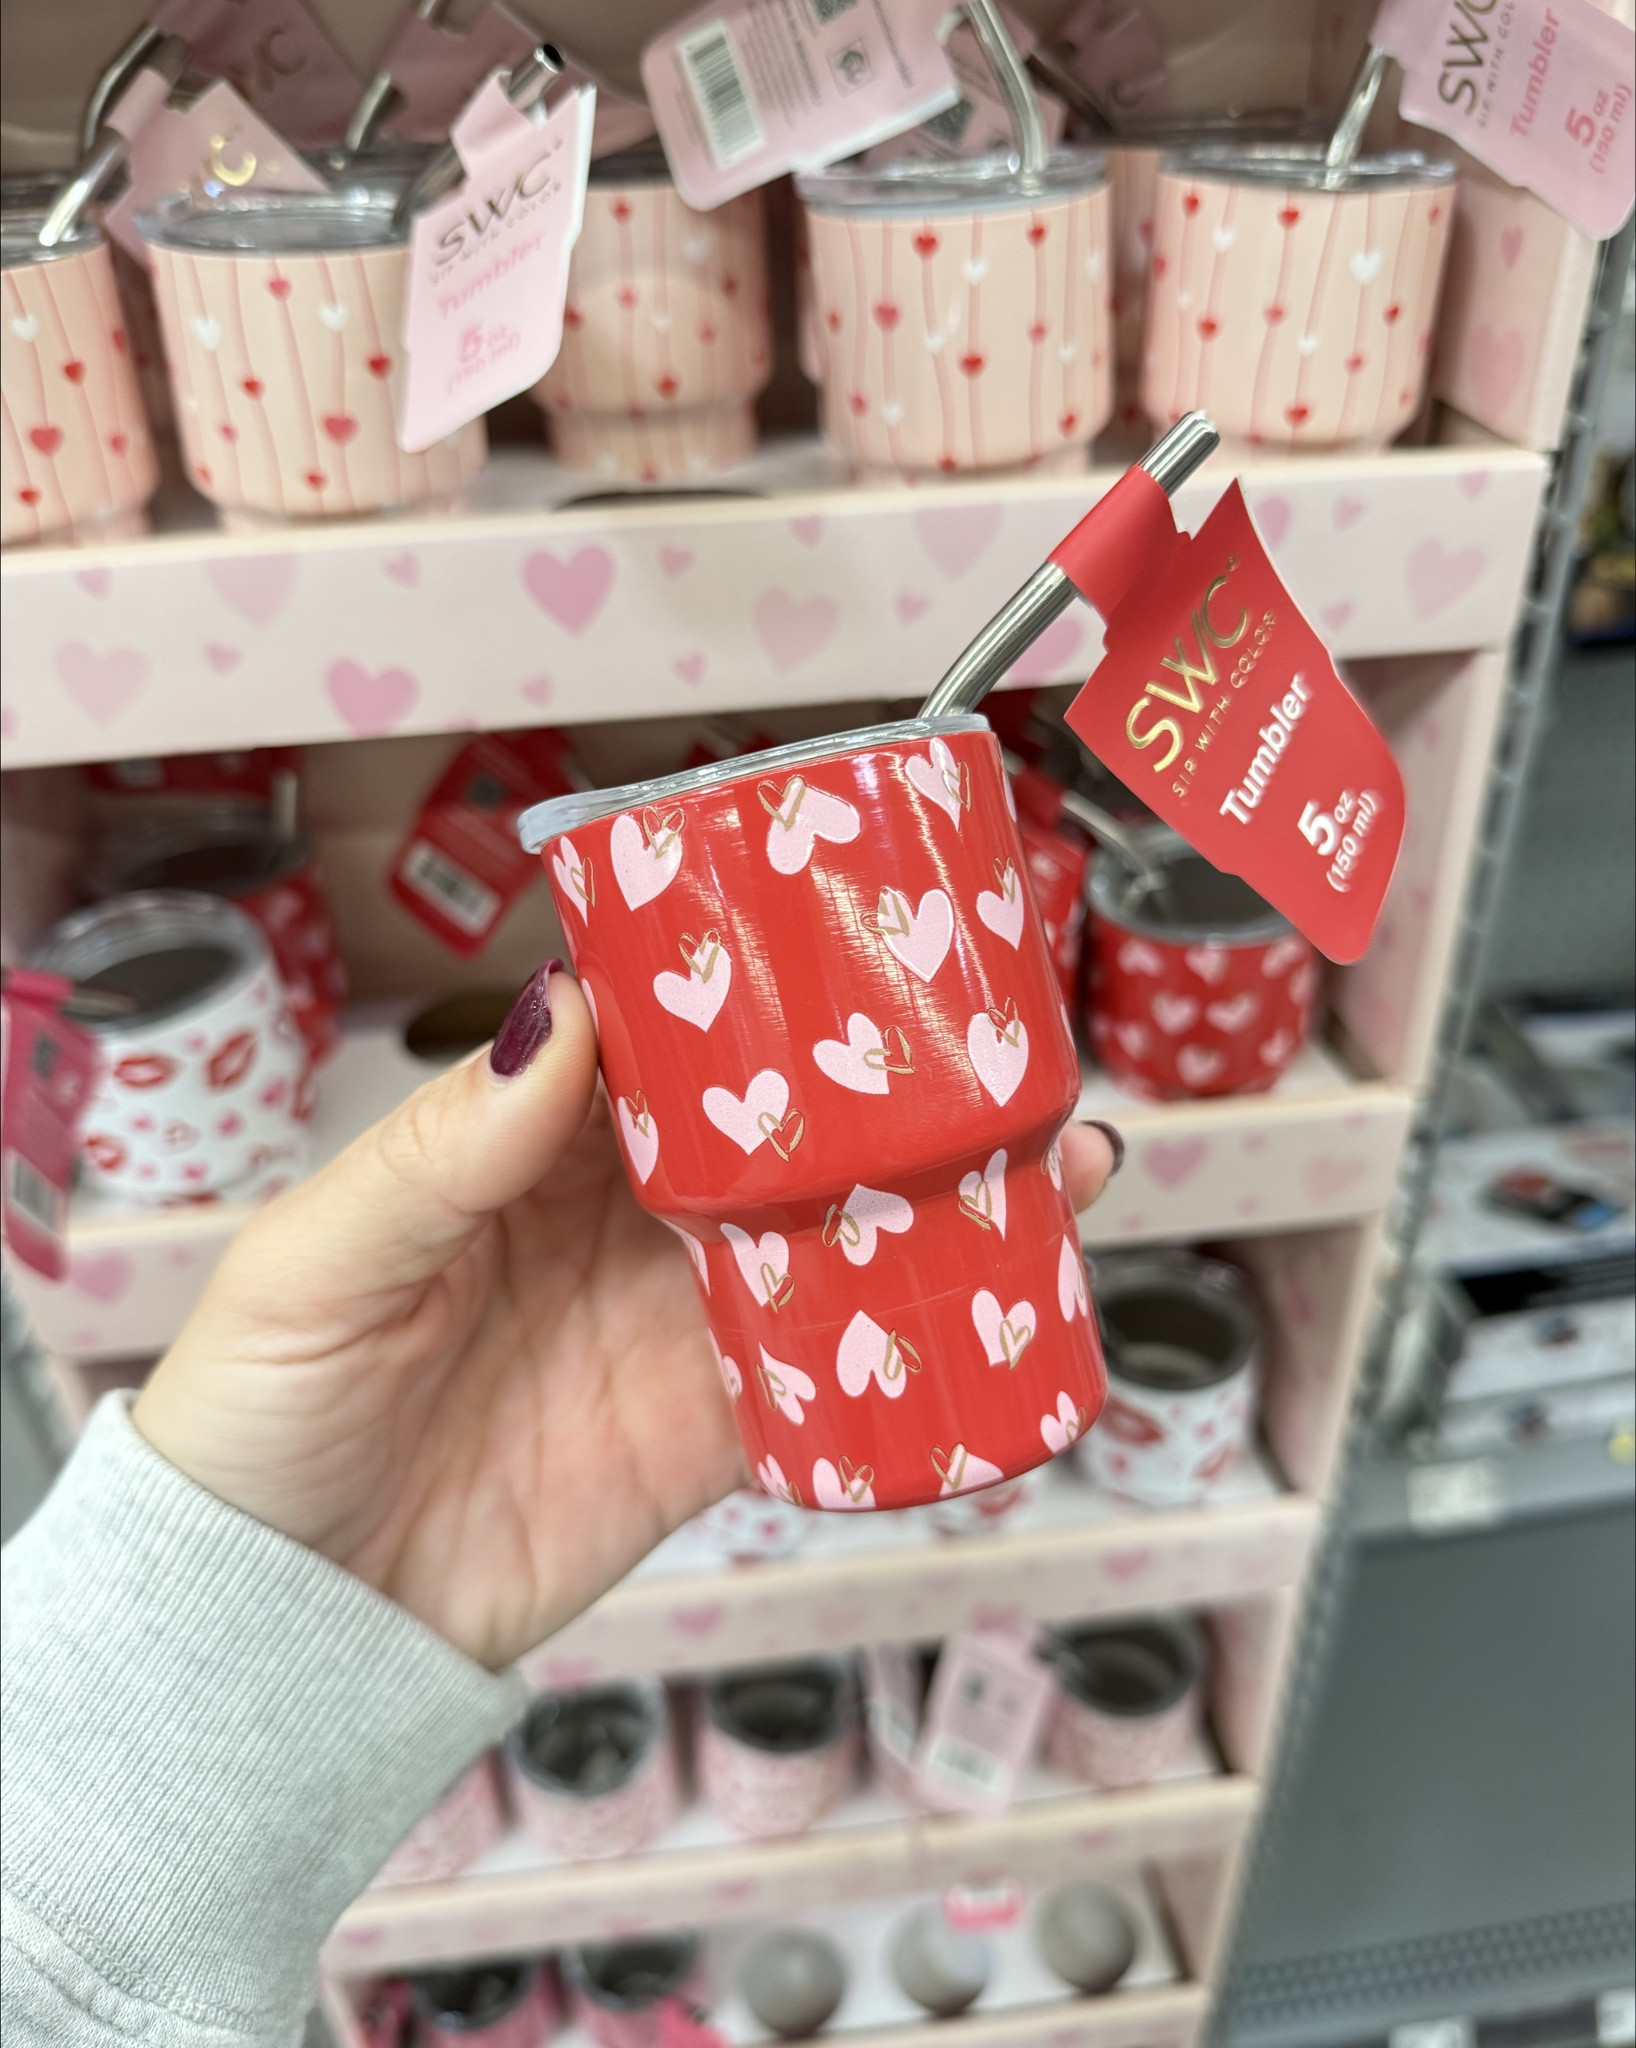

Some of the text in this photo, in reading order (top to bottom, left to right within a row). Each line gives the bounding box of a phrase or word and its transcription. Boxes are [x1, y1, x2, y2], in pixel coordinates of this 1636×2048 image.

[1510, 8, 1559, 136] Tumbler
[1565, 106, 1596, 148] 5
[436, 153, 553, 267] SWC
[1172, 609, 1278, 798] SIP WITH COLOR
[1218, 670, 1312, 825] Tumbler
[1297, 789, 1357, 856] 5 oz
[1326, 788, 1384, 893] (150 ml)
